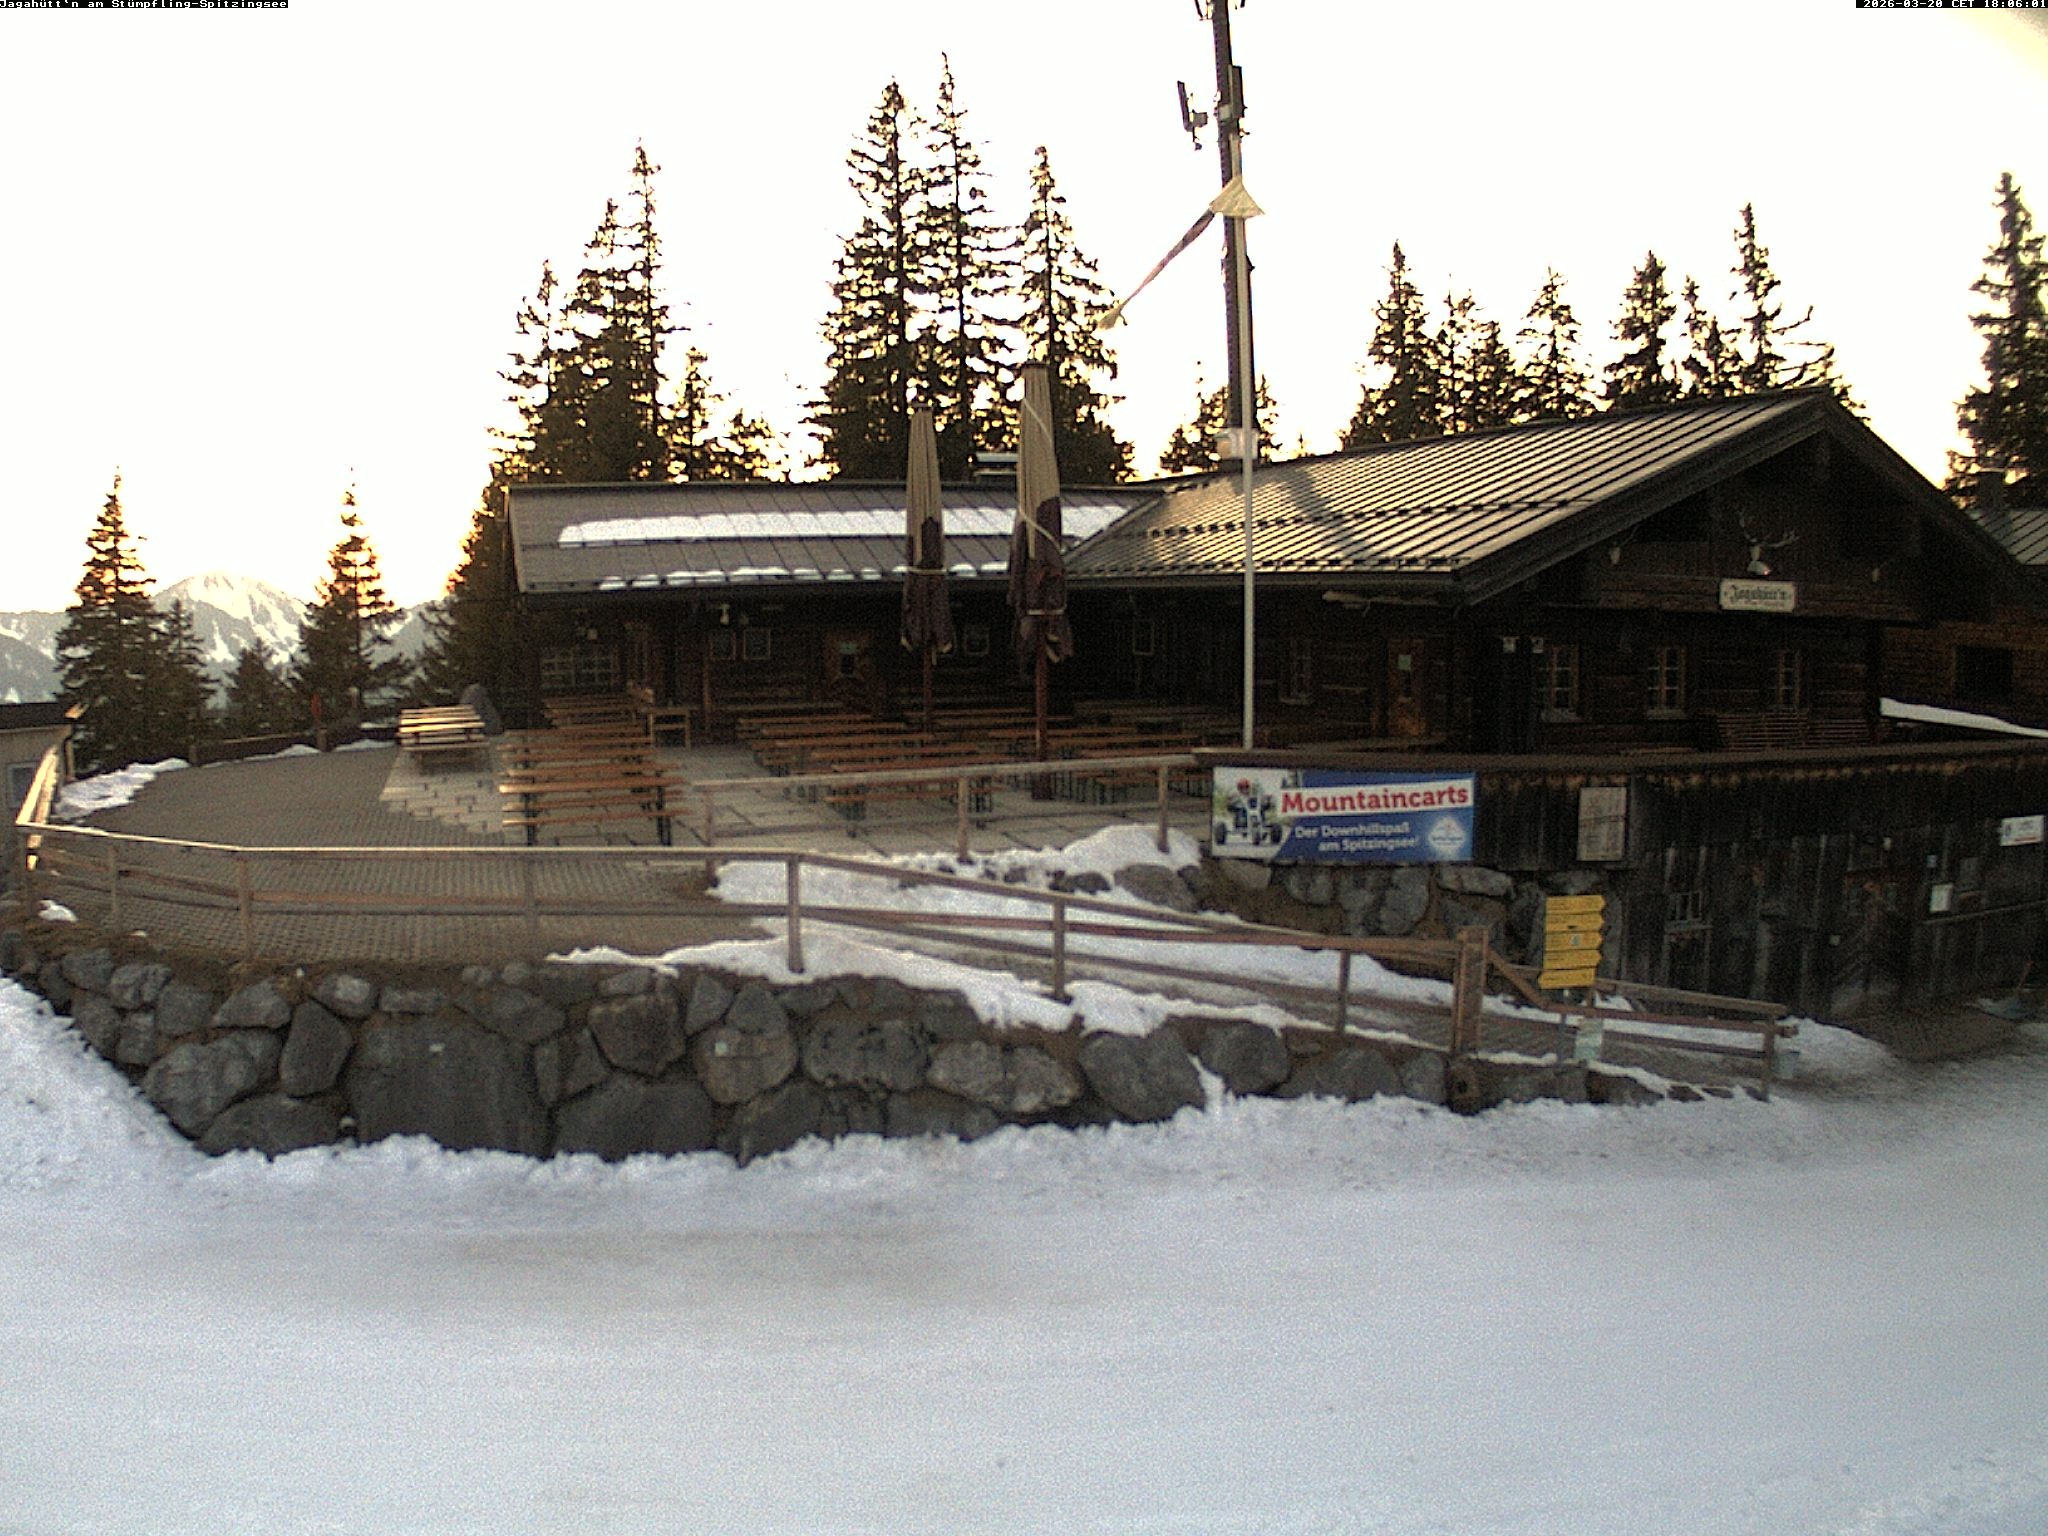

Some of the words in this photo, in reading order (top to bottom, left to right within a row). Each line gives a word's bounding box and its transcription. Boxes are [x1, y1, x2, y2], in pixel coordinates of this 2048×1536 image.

[1281, 785, 1469, 814] Mountaincarts
[1295, 825, 1319, 838] Der
[1318, 842, 1340, 852] am
